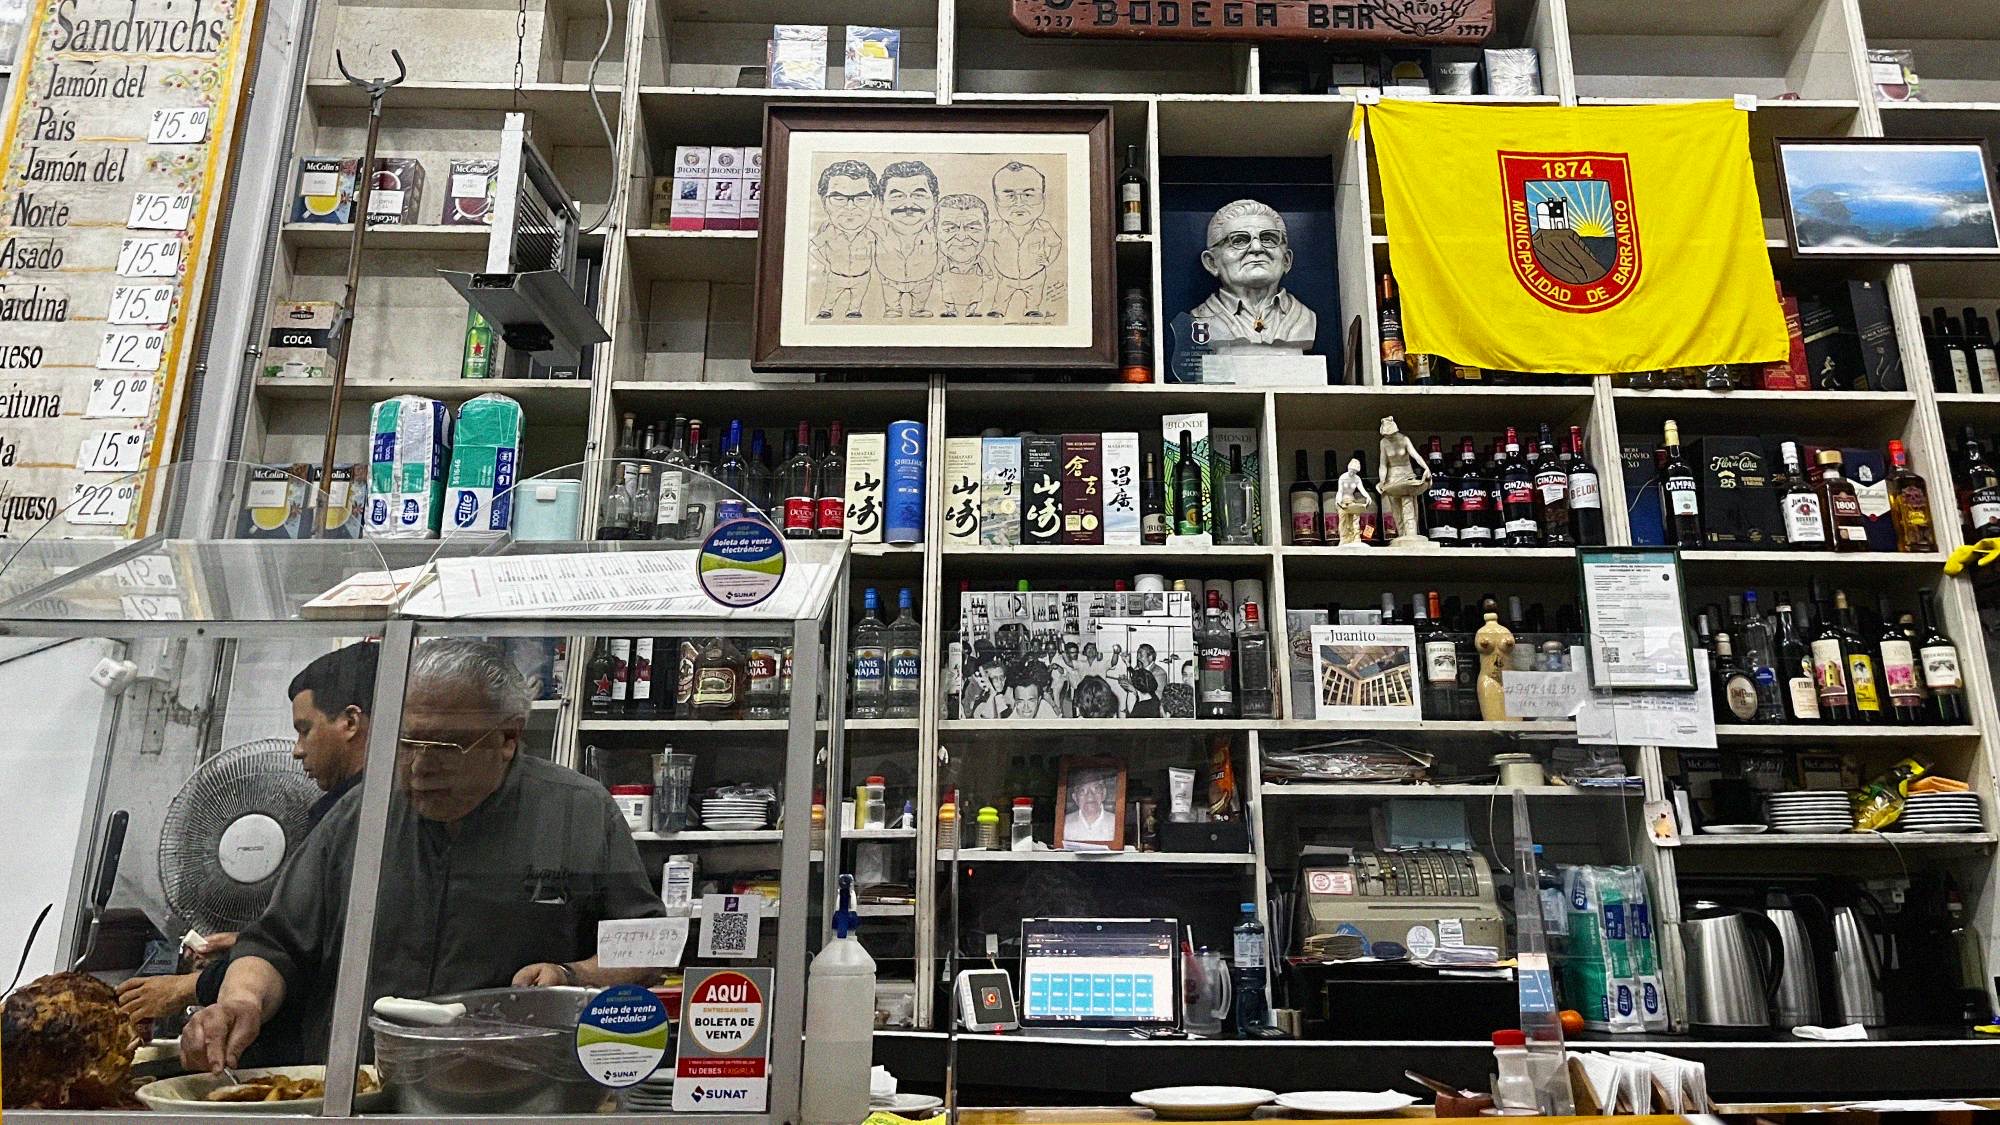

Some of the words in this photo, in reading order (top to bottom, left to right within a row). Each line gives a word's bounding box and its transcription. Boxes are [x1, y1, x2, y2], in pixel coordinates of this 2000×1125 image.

[1094, 1, 1278, 28] BODEGA
[1308, 4, 1374, 29] BAR
[51, 0, 224, 53] Sandwichs
[43, 64, 110, 100] Jamón
[112, 65, 147, 98] del
[33, 106, 76, 142] País
[20, 147, 88, 182] Jamón
[93, 148, 128, 182] del
[306, 162, 339, 171] McColin's
[1542, 160, 1593, 179] 1874
[10, 192, 69, 228] Norte
[0, 238, 63, 271] Asado
[1512, 200, 1571, 302] MUNICIPALIDAD
[1587, 287, 1609, 303] DE
[1613, 200, 1634, 286] BARRANCO
[283, 335, 312, 345] COCA
[901, 428, 919, 455] S
[315, 470, 350, 480] Molin's
[1537, 476, 1565, 486] CINZANO
[1458, 488, 1487, 498] CINZANO
[374, 500, 383, 521] Elite
[459, 494, 472, 522] Elite
[1836, 501, 1856, 510] 1800
[713, 539, 738, 548] Boleta
[739, 538, 749, 547] de
[751, 536, 773, 545] venta
[722, 545, 764, 554] electrónica
[1330, 629, 1376, 643] Juanito
[1201, 647, 1231, 658] CINZANO
[858, 660, 878, 669] ANIS
[897, 659, 916, 668] ANIS
[854, 668, 880, 678] NAJAR
[894, 668, 918, 678] NAJAR
[706, 981, 748, 1003] AQUÍ
[591, 1006, 619, 1016] Boleta
[620, 1005, 632, 1014] de
[633, 1004, 657, 1014] venta
[600, 1014, 647, 1024] electrónica
[695, 1018, 738, 1028] BOLETA
[741, 1018, 755, 1027] DE
[706, 1030, 742, 1040] VENTA
[612, 1071, 638, 1079] SUNAT
[706, 1090, 748, 1099] SUNAT
